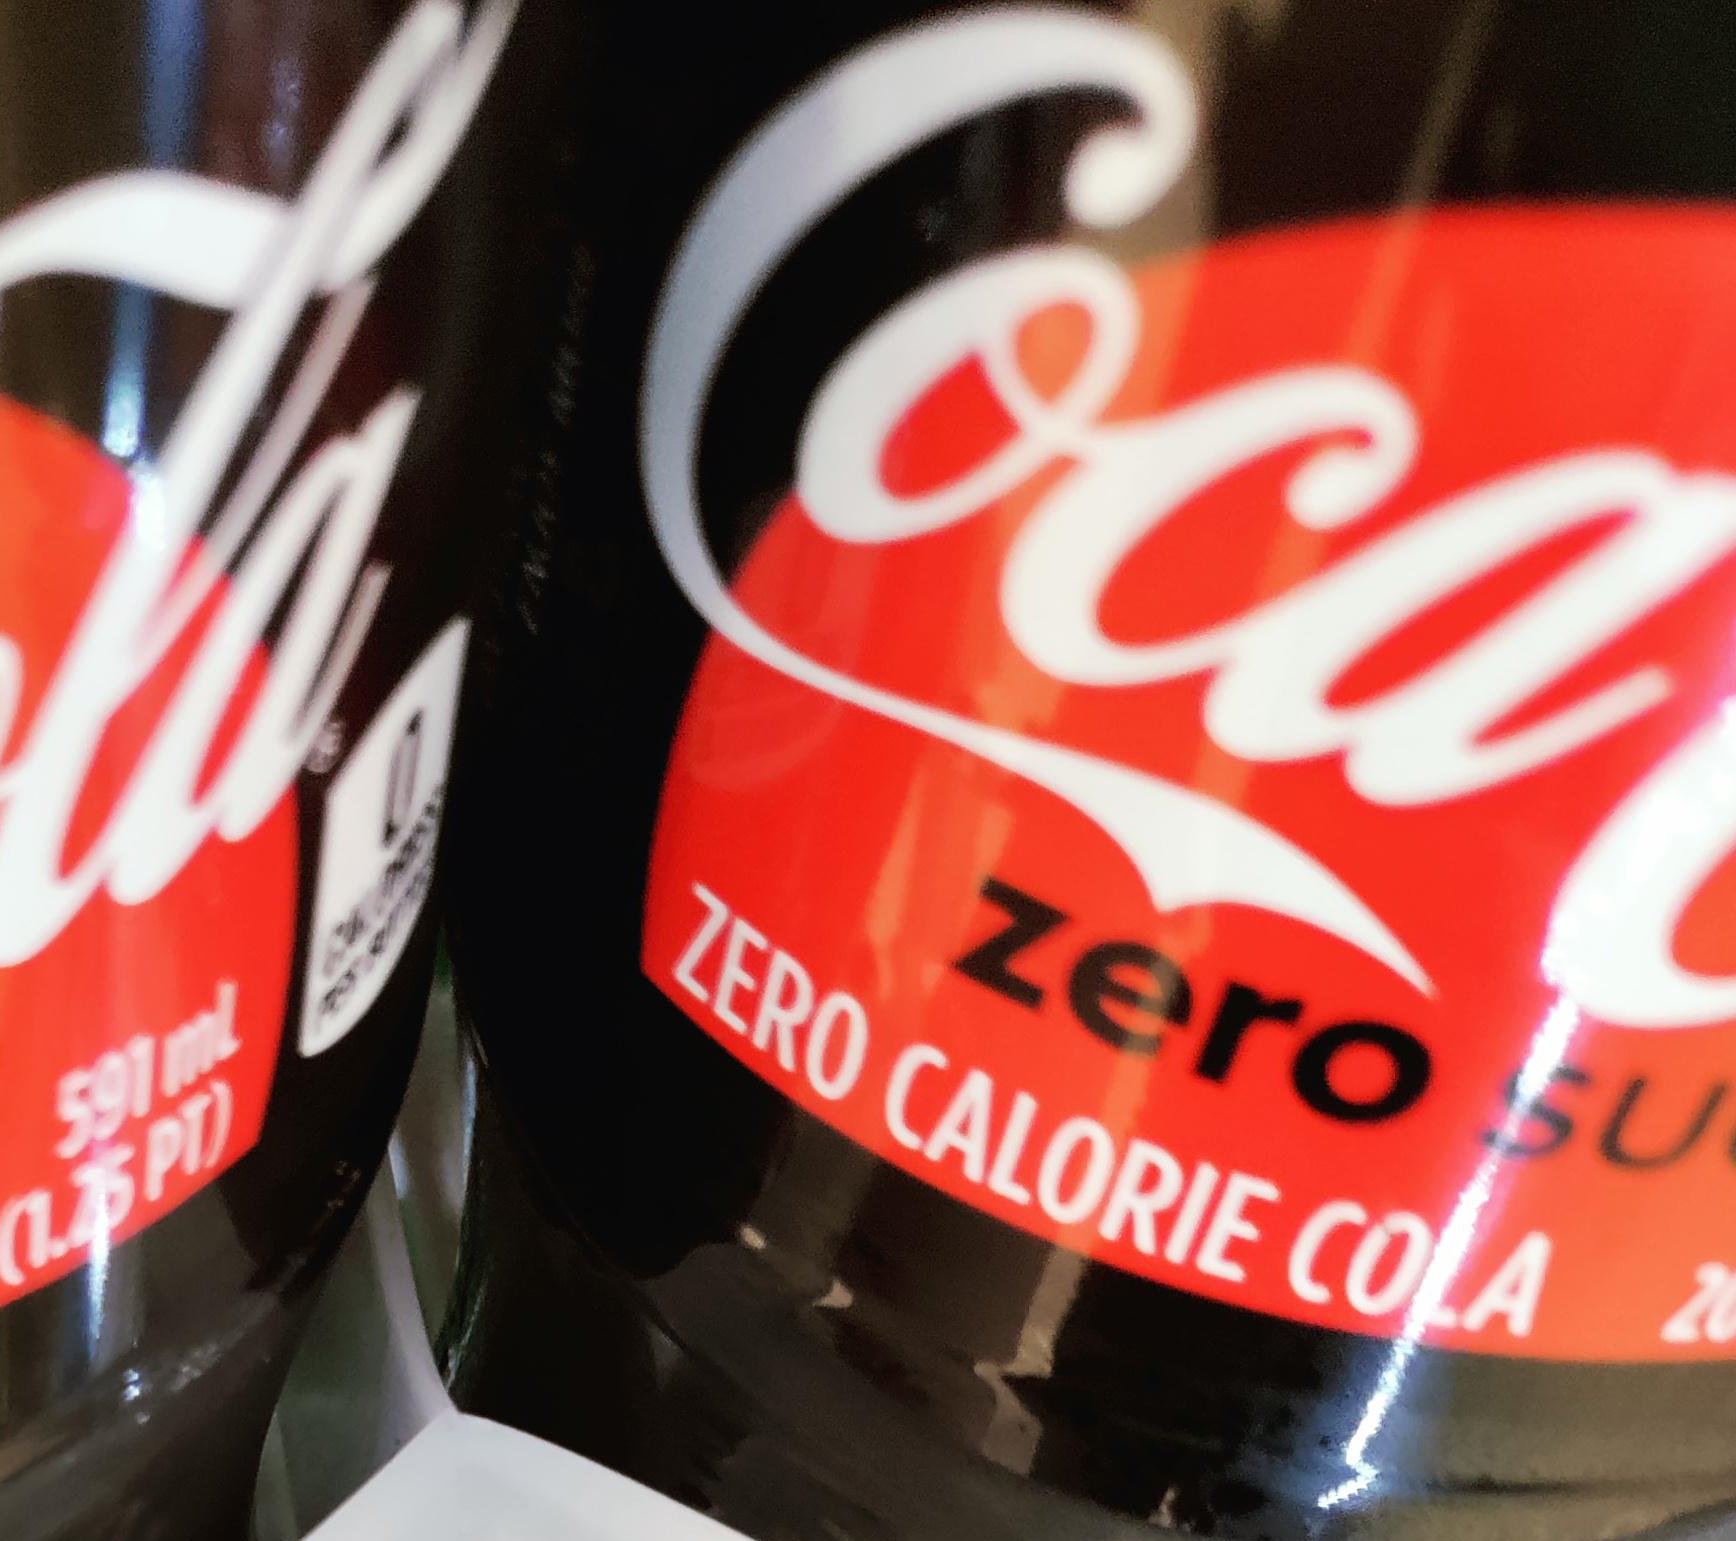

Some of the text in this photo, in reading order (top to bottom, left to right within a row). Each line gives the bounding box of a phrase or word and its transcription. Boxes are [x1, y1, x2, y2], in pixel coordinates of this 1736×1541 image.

[55, 1031, 157, 1161] 591
[672, 879, 870, 1102] ZERO
[884, 1041, 1283, 1284] CALORIE
[1288, 1200, 1553, 1340] COLA
[949, 873, 1736, 1172] zero SU
[143, 1078, 235, 1203] PT)
